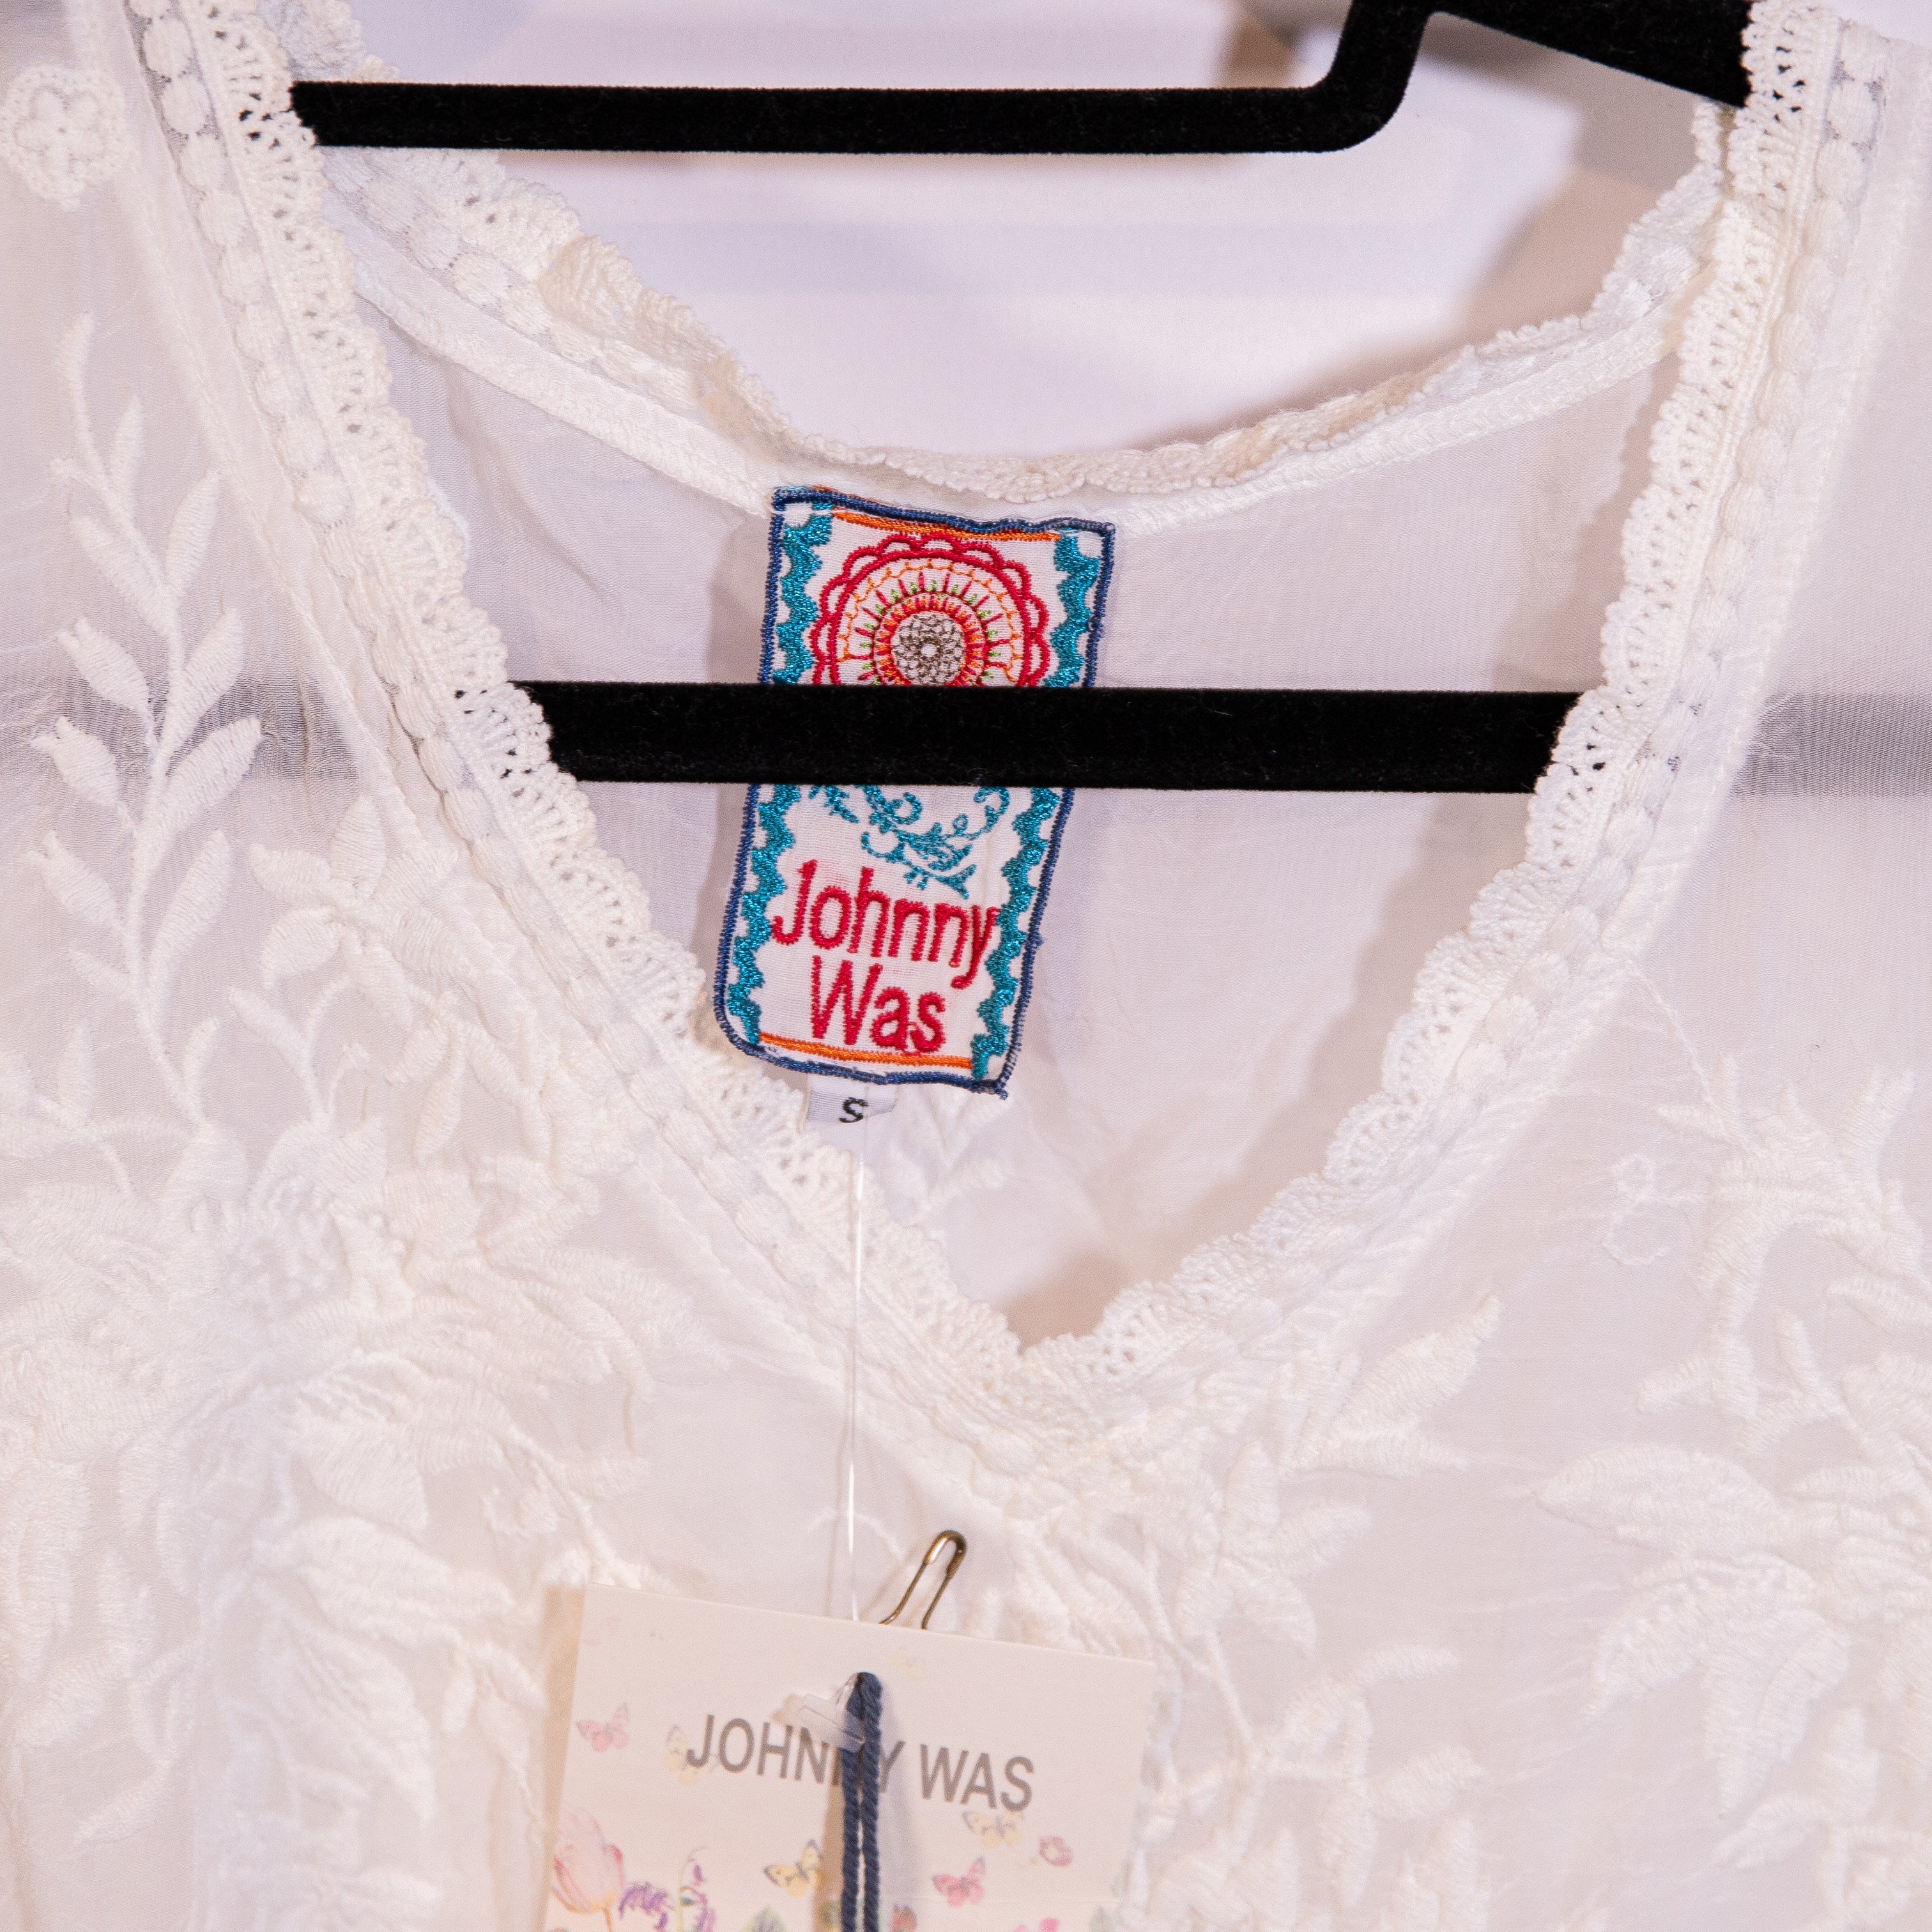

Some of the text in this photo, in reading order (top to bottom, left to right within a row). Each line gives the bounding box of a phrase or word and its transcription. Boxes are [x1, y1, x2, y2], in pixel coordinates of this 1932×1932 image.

[771, 859, 1000, 988] Johnny
[810, 955, 946, 1054] Was
[838, 1096, 868, 1123] S
[919, 1744, 1035, 1812] WAS
